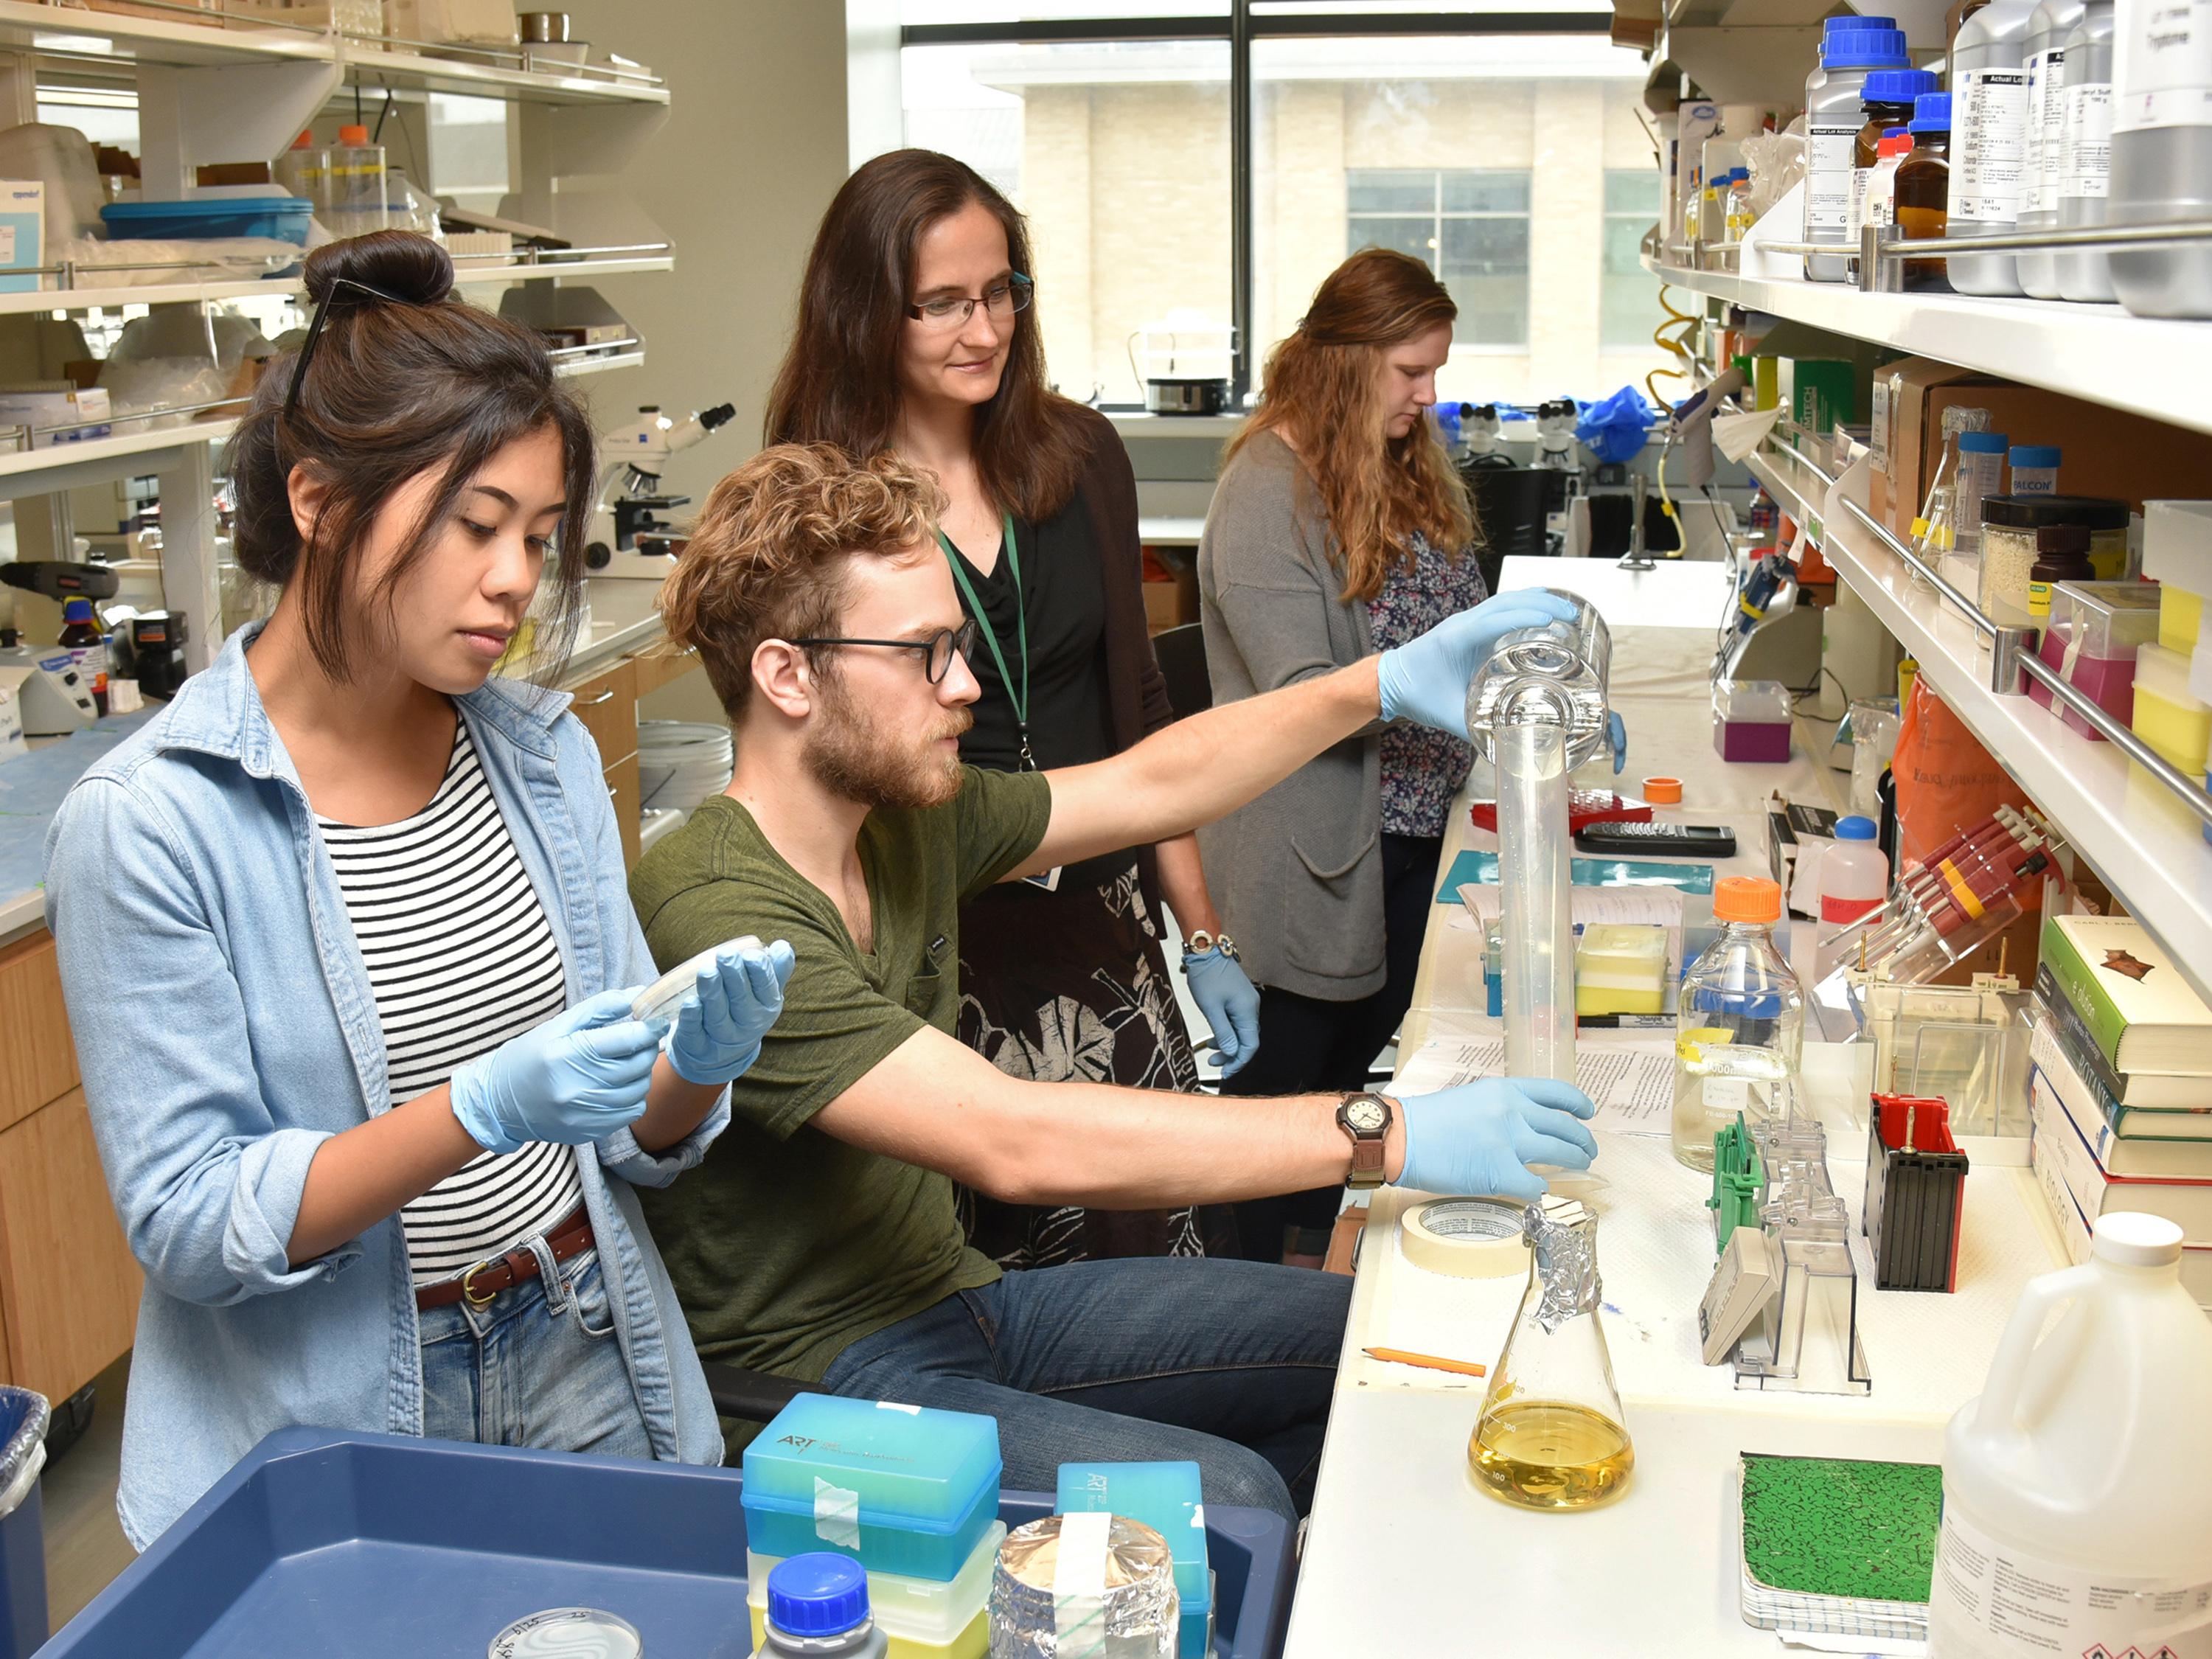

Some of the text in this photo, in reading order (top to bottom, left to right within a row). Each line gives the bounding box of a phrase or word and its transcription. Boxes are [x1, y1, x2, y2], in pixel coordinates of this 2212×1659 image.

[2046, 1169, 2070, 1232] BIOLOGY
[1502, 1421, 1517, 1433] 300
[776, 1434, 816, 1453] ART
[1085, 1472, 1109, 1492] ART
[1492, 1472, 1506, 1483] 100
